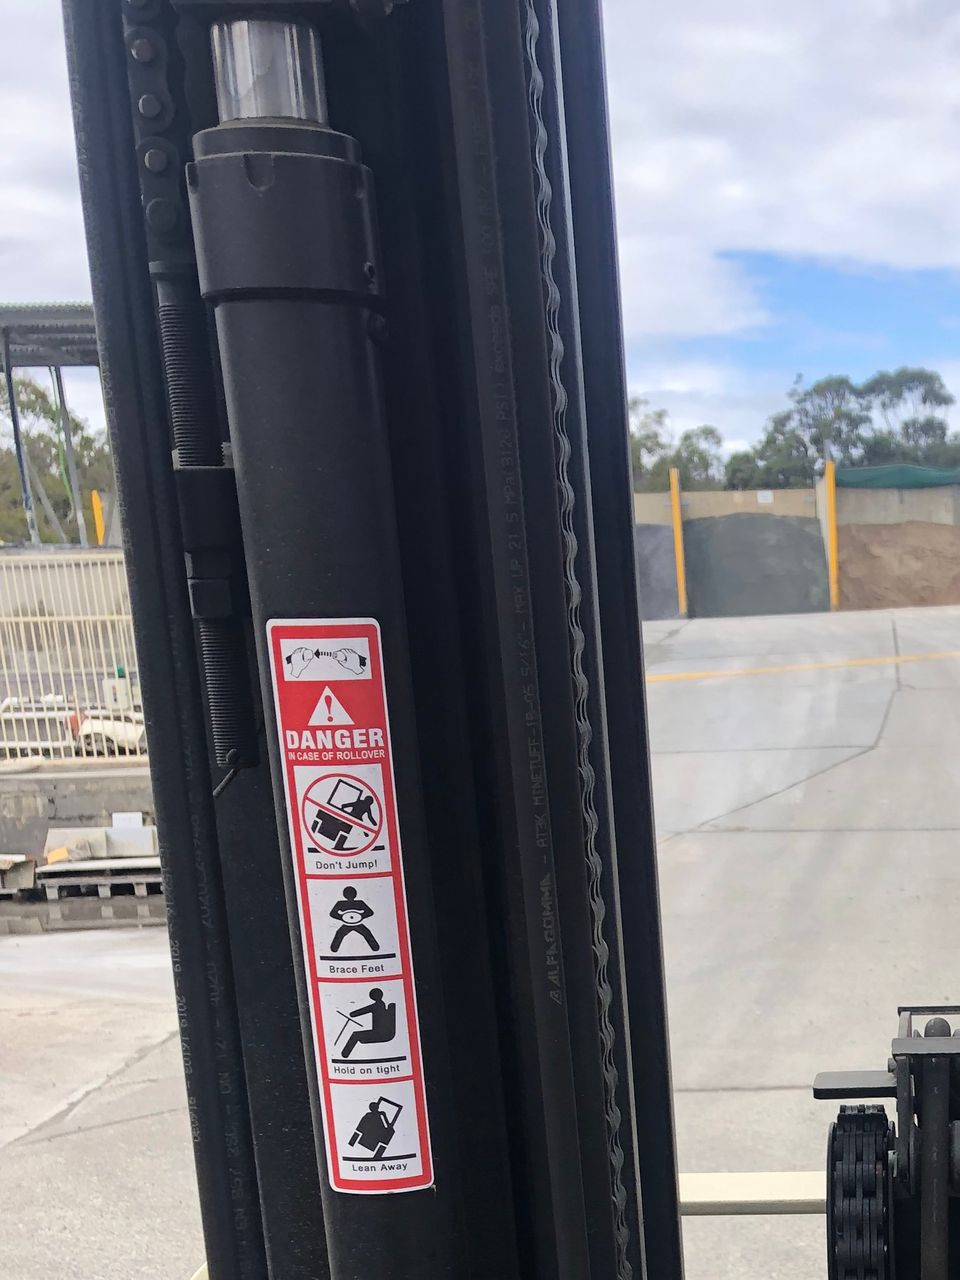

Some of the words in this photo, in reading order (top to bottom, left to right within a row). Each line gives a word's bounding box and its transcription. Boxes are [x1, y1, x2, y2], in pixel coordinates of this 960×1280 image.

[286, 728, 384, 749] DANGER
[288, 752, 296, 760] IN
[297, 751, 320, 760] CASE
[322, 751, 334, 760] OF
[336, 750, 385, 760] ROLLOVER
[315, 860, 344, 870] Don't
[345, 859, 378, 870] Jump!
[329, 964, 358, 974] Brace
[360, 963, 385, 973] Feet
[333, 1065, 357, 1075] Hold
[359, 1066, 373, 1075] on
[376, 1063, 401, 1076] tight
[351, 1162, 377, 1172] Lean
[379, 1161, 408, 1173] Away
